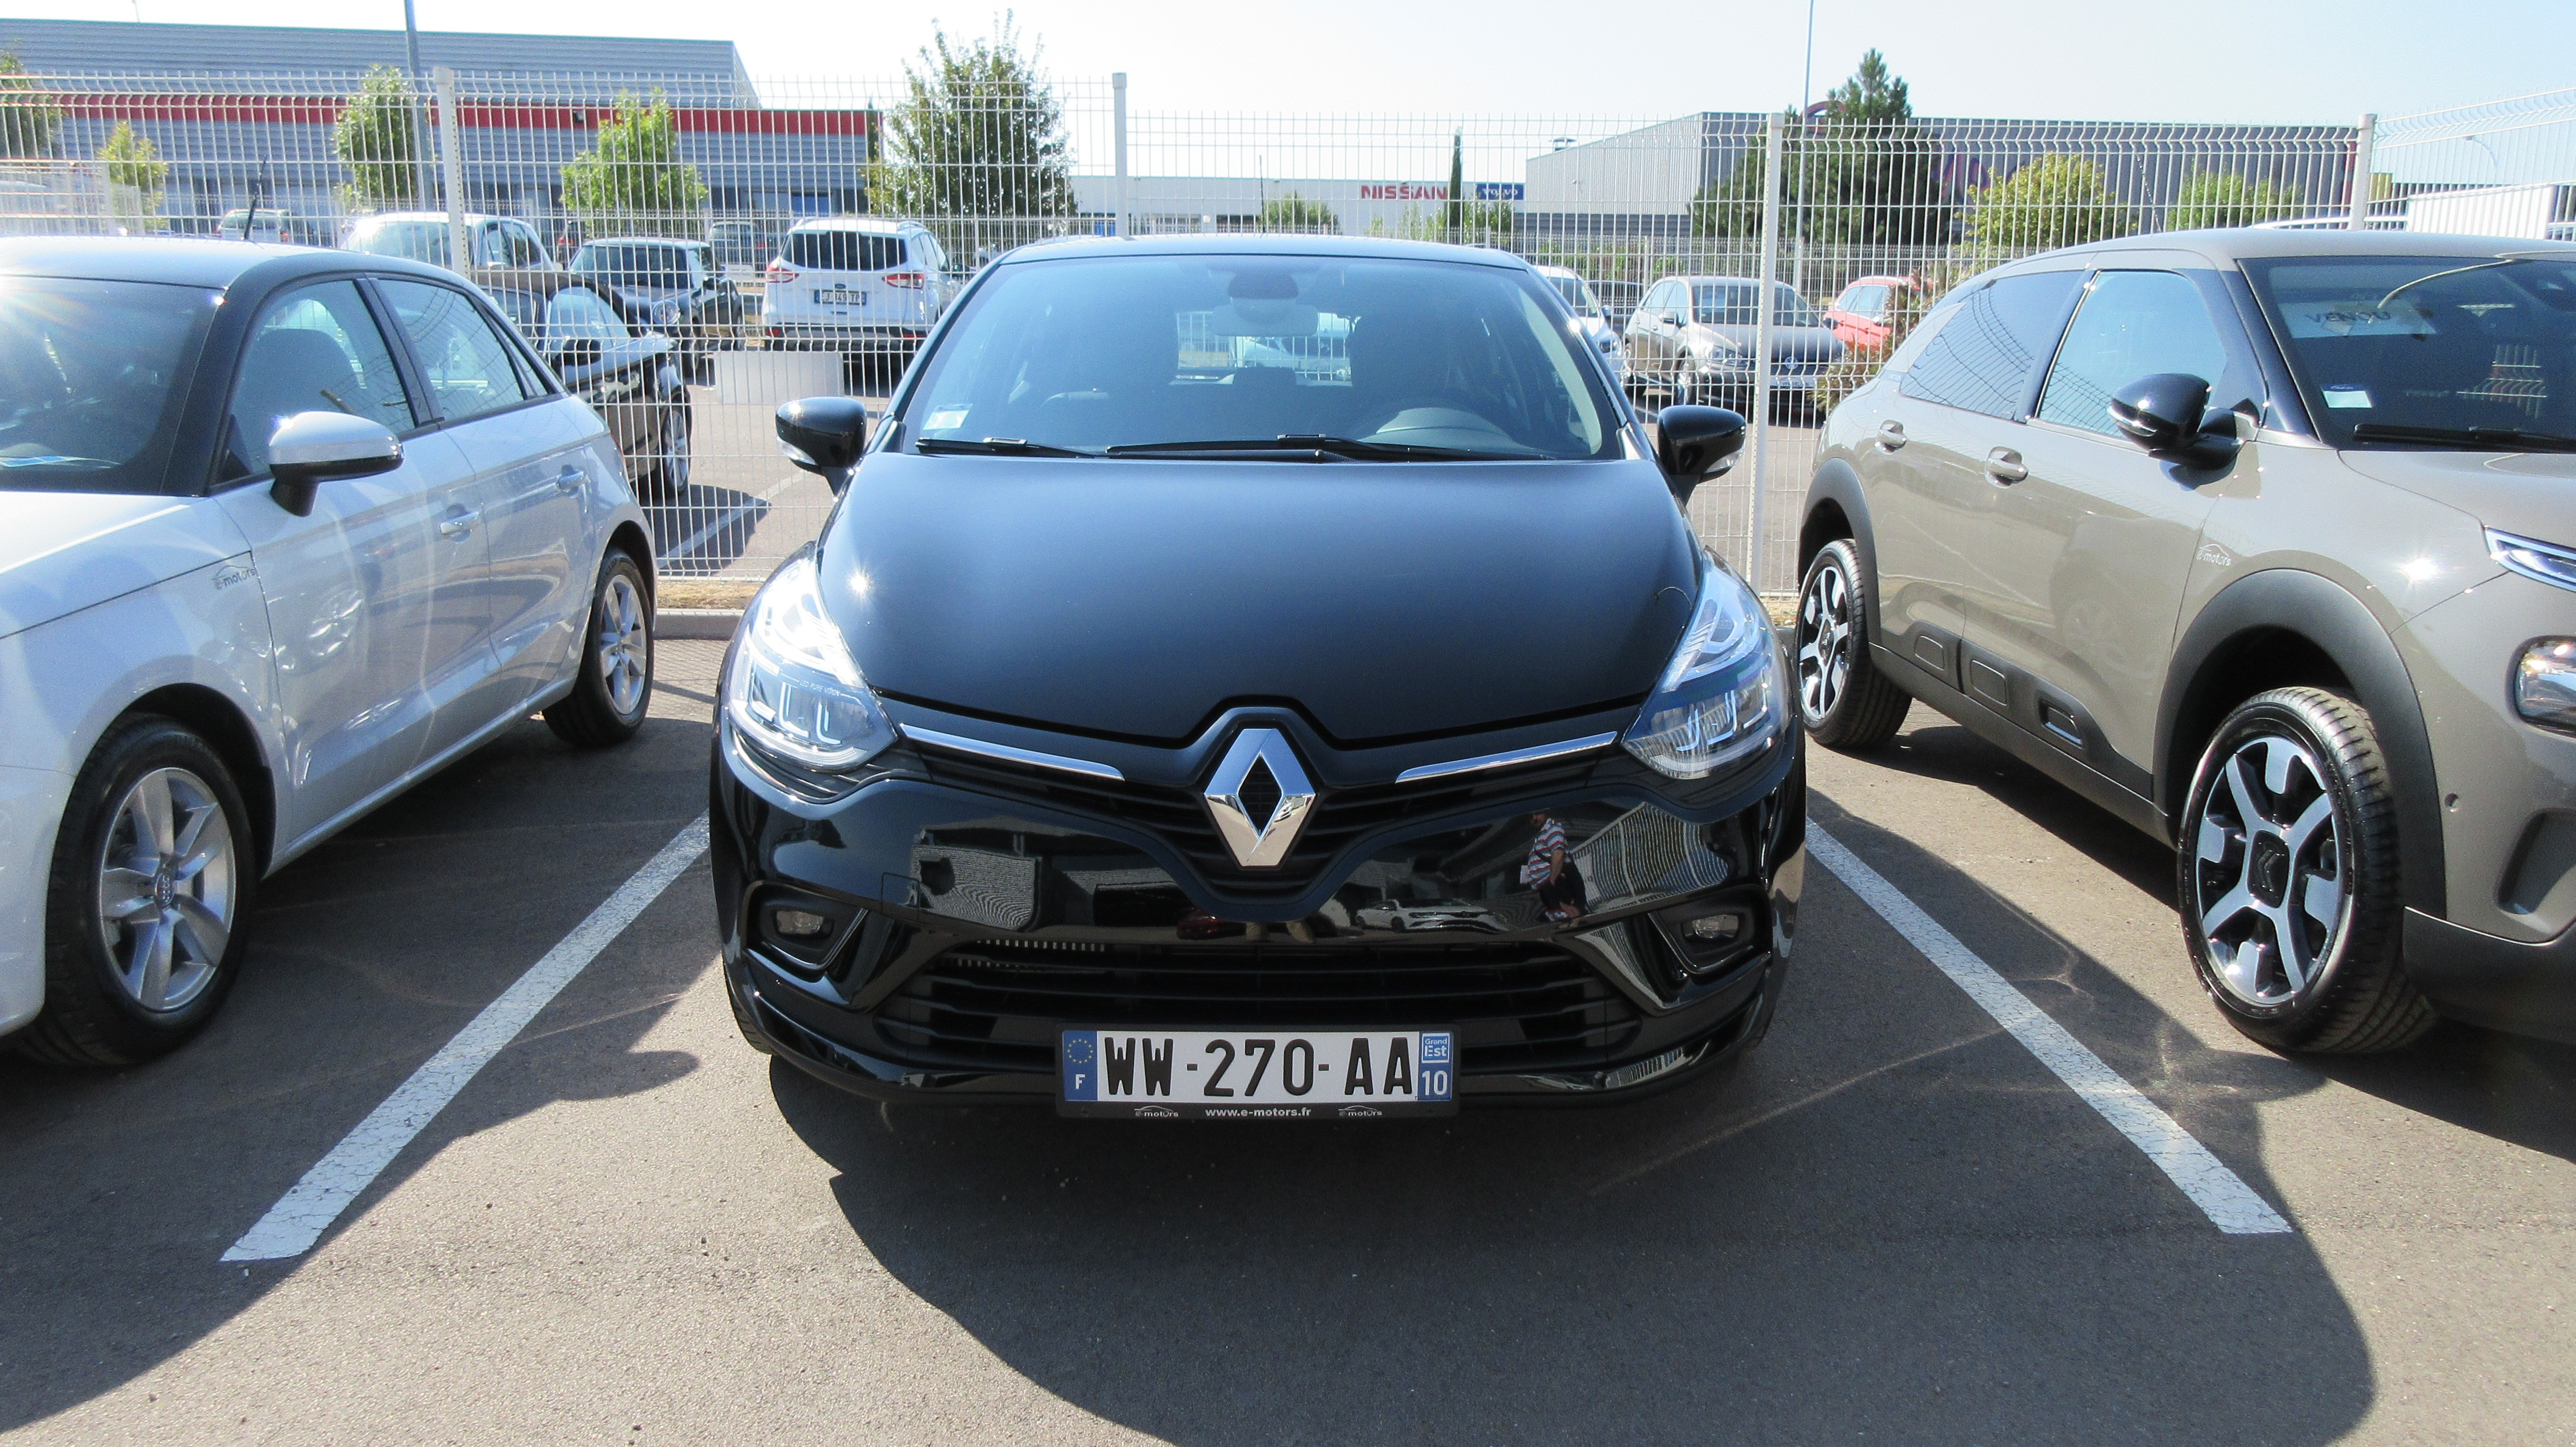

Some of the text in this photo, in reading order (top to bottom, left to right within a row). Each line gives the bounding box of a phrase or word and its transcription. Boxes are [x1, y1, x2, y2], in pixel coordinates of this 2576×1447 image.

[1362, 186, 1448, 199] NISSAN
[1424, 1045, 1447, 1057] Est
[1075, 1073, 1085, 1090] F
[1422, 1070, 1448, 1096] 10
[1205, 1107, 1311, 1117] www.e-motors.fr
